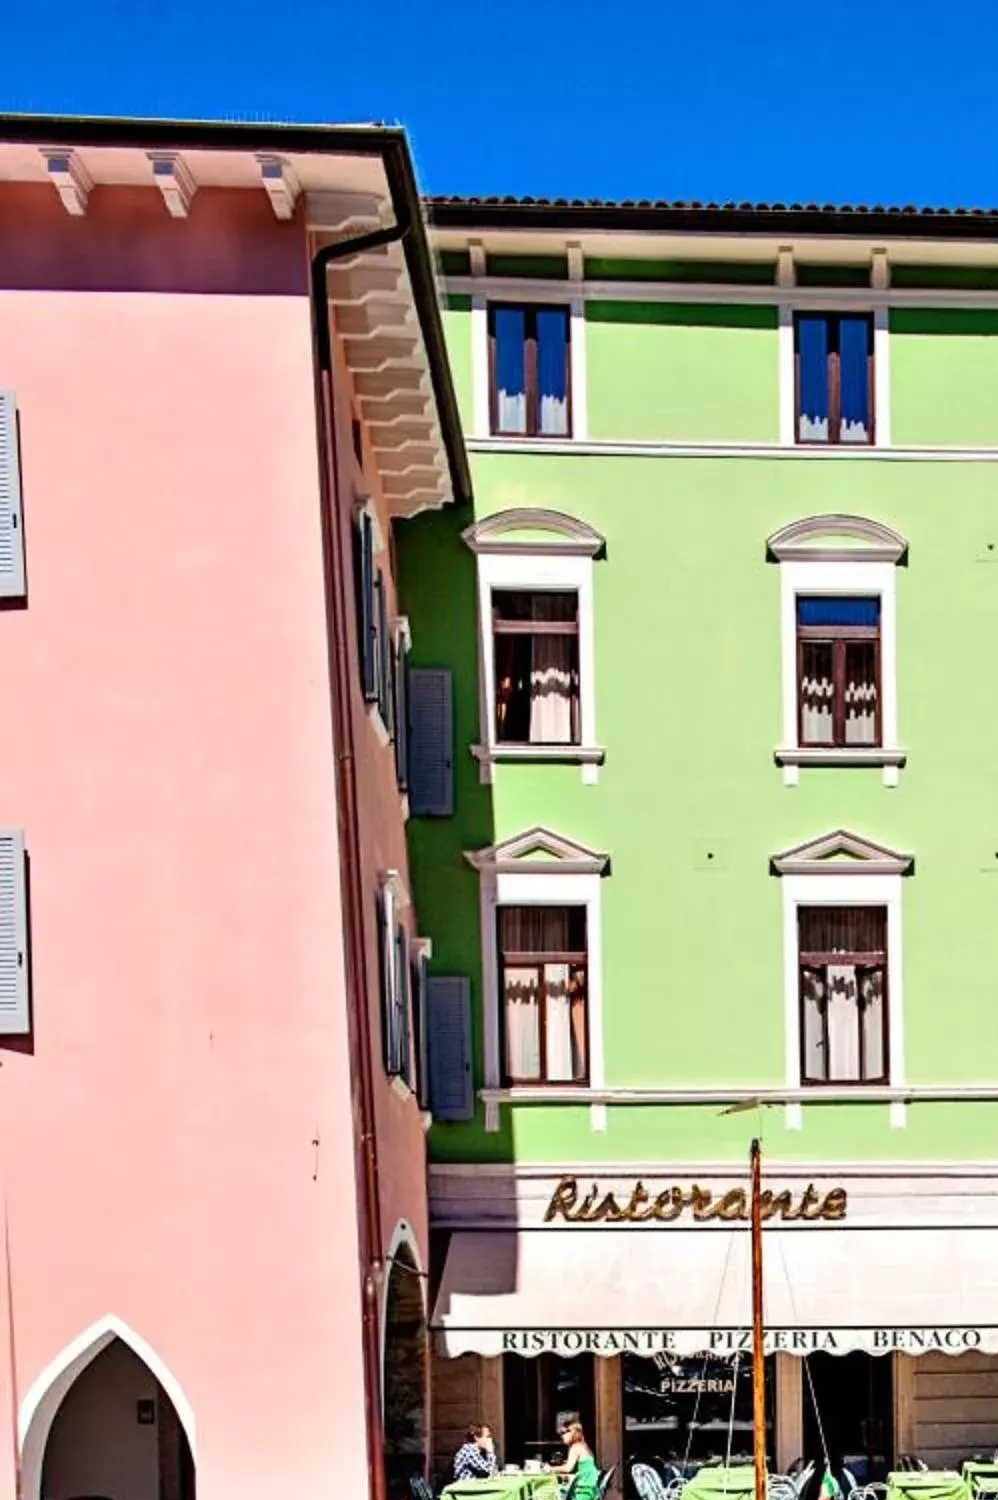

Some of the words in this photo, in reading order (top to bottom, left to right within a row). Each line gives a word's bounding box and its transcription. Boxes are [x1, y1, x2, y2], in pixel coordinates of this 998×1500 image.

[544, 1175, 848, 1222] Ristorante
[502, 1331, 676, 1350] RISTORANTE
[873, 1329, 981, 1349] BENACO
[660, 1379, 735, 1393] PIZZERIA
